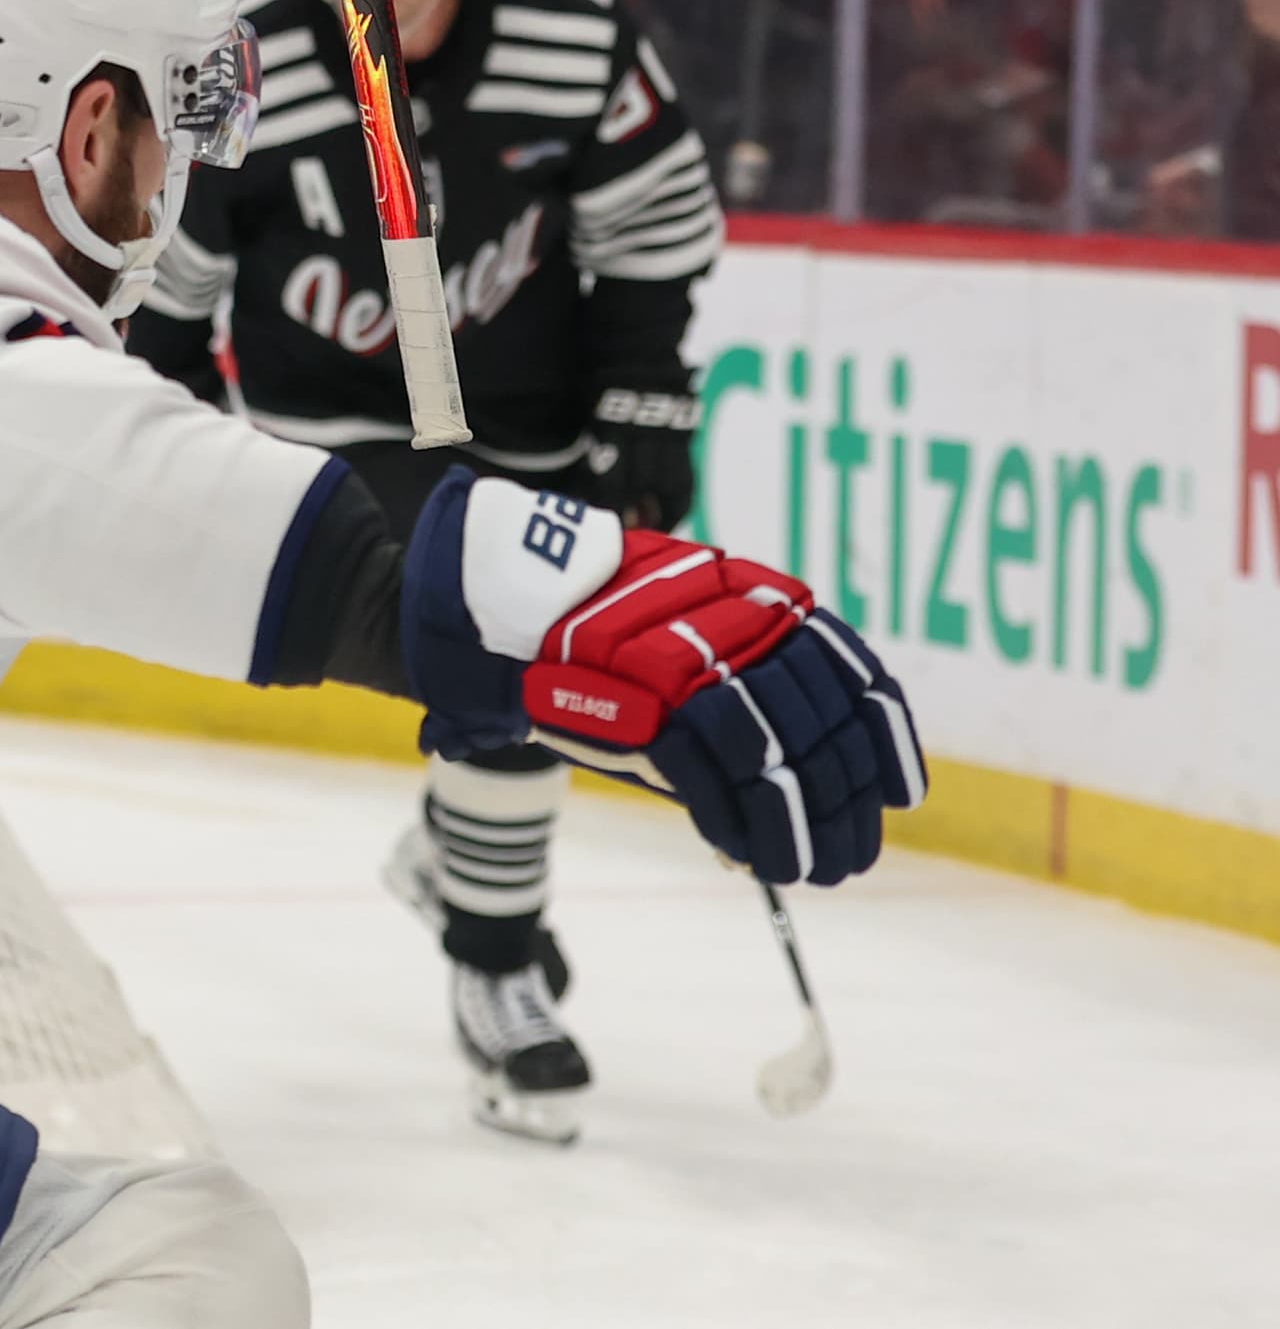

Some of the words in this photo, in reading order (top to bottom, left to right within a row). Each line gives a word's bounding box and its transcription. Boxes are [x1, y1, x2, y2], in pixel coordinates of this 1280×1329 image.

[290, 157, 345, 237] A
[690, 343, 1168, 693] Citizens
[552, 687, 620, 722] WILSON
